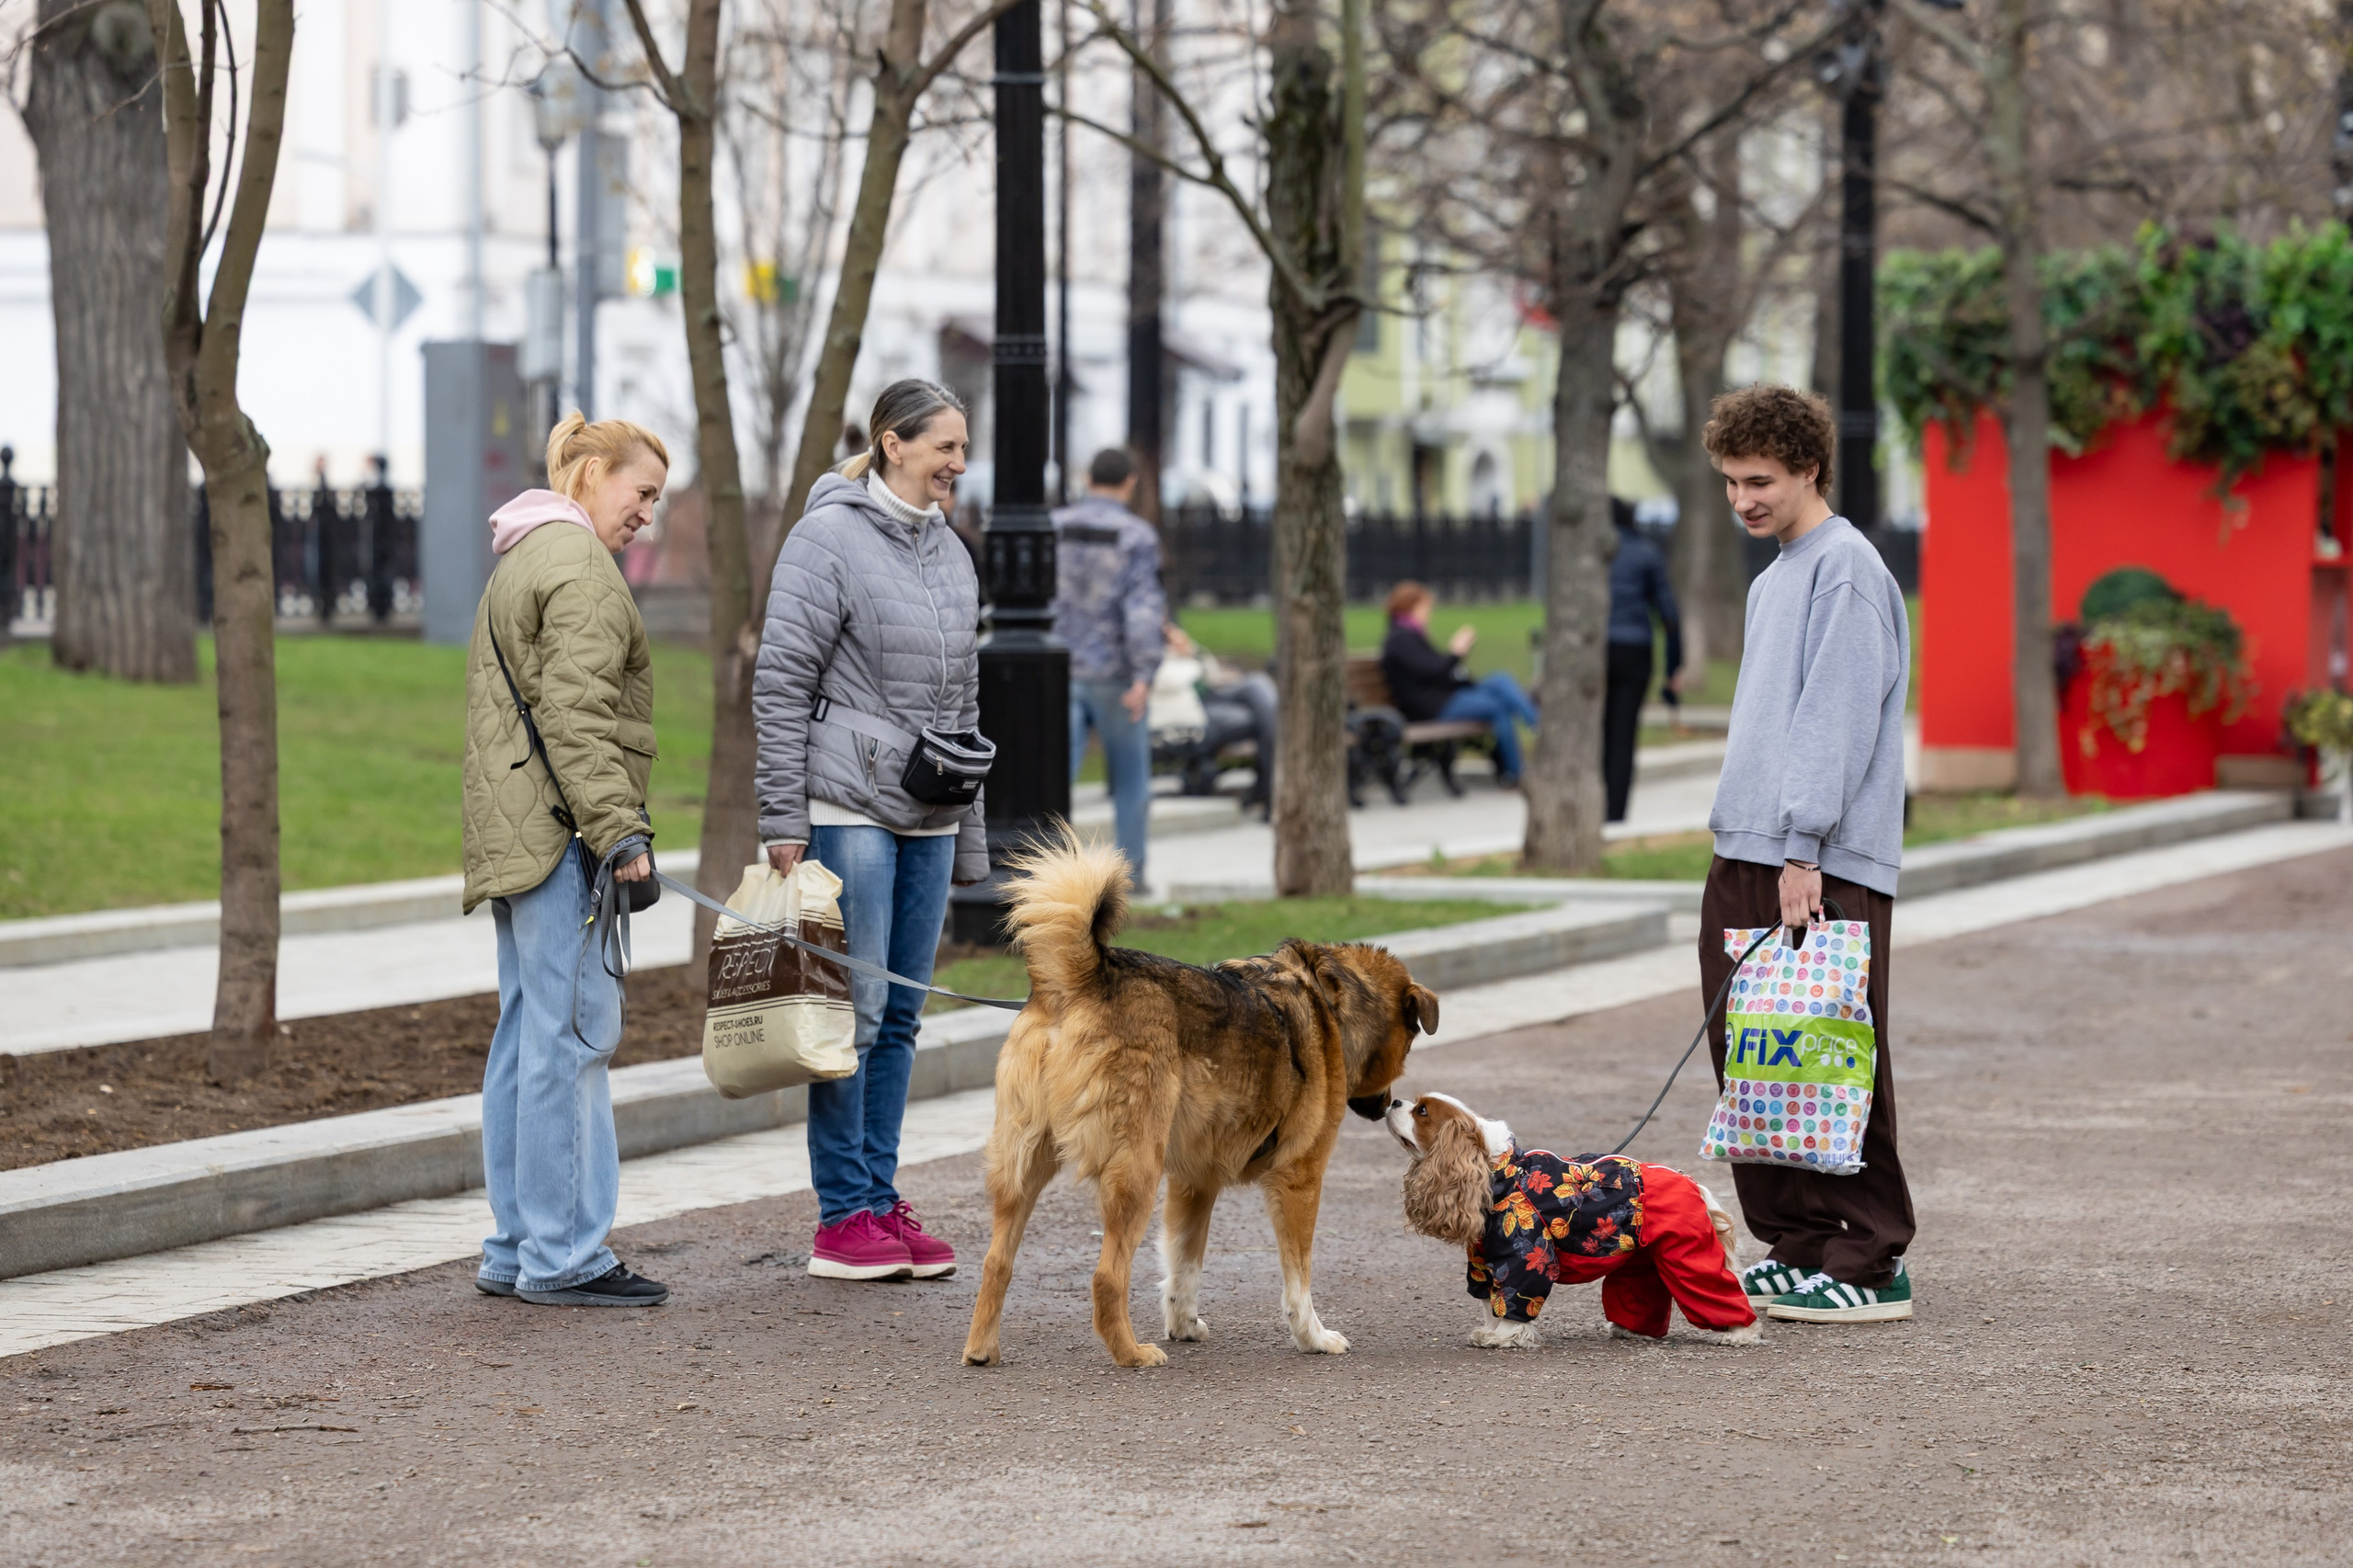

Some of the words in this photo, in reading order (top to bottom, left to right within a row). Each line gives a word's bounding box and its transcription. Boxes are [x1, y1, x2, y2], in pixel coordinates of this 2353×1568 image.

[713, 1016, 763, 1031] RESPECT-SHOES.RU
[714, 1034, 733, 1049] SHOP
[733, 1028, 766, 1046] ONLINE
[1801, 1034, 1858, 1056] price
